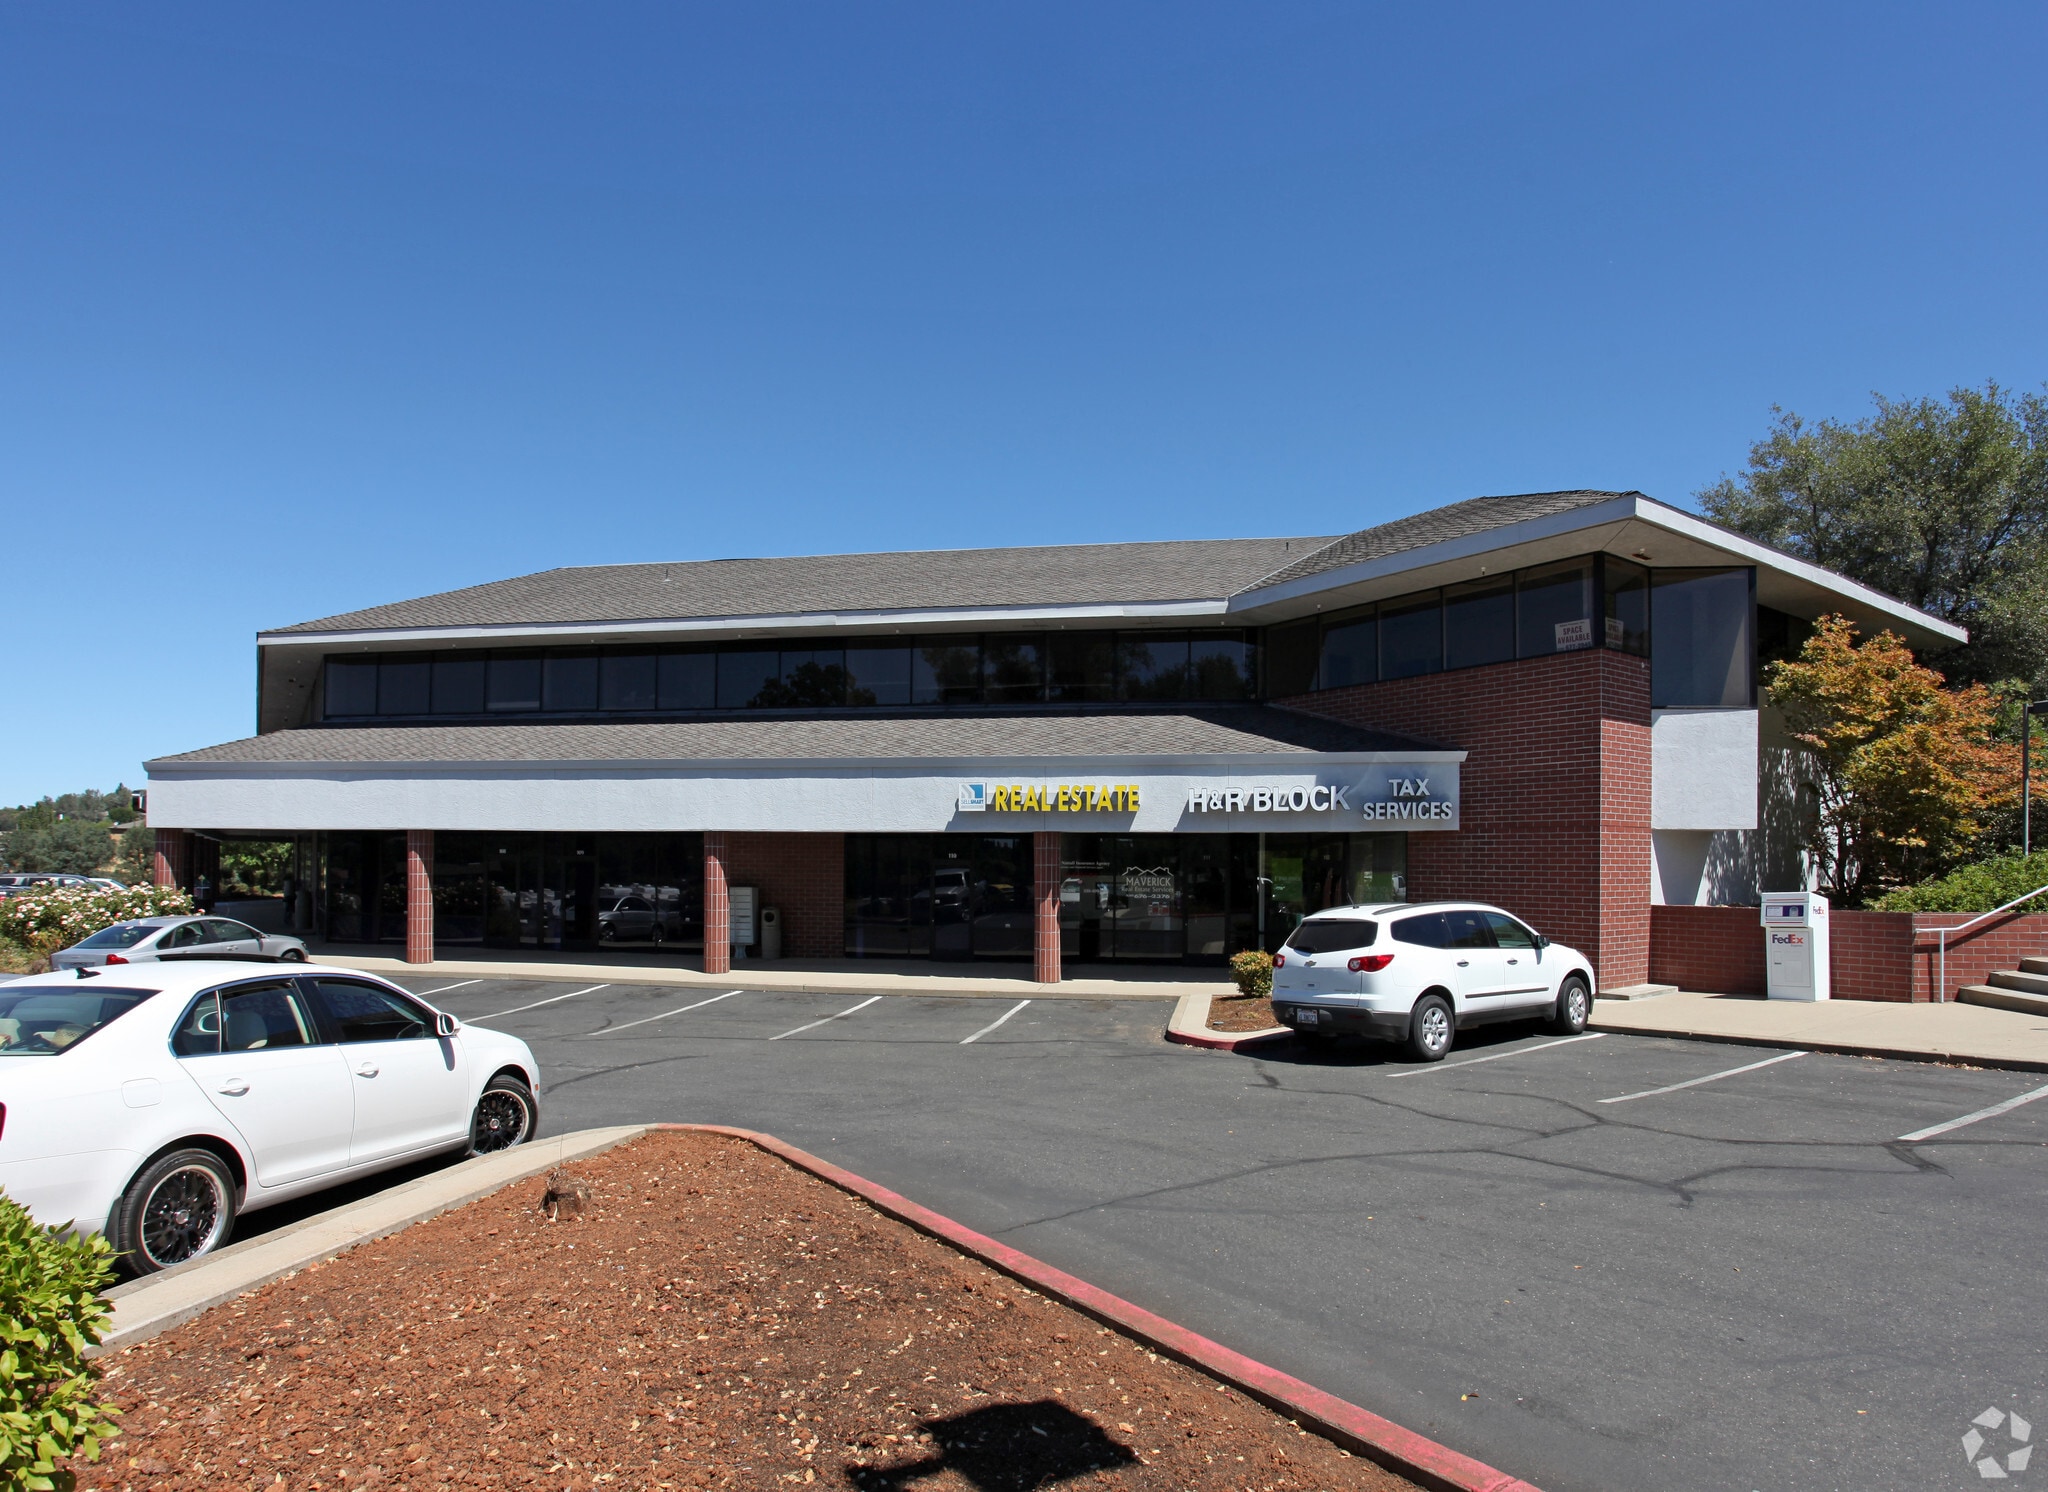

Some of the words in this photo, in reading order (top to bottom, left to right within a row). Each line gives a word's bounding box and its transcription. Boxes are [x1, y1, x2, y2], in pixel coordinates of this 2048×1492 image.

[1563, 625, 1583, 635] SPACE
[1557, 633, 1591, 644] AVAILABLE
[1388, 778, 1431, 797] TAX
[995, 784, 1053, 812] REAL
[1058, 784, 1141, 812] ESTATE
[1188, 787, 1245, 813] H&R
[1253, 785, 1351, 812] BLOCK
[1363, 801, 1453, 821] SERVICES
[1126, 877, 1171, 887] MAVERICK
[1813, 905, 1825, 915] FedEx
[1772, 933, 1804, 944] FedEx
